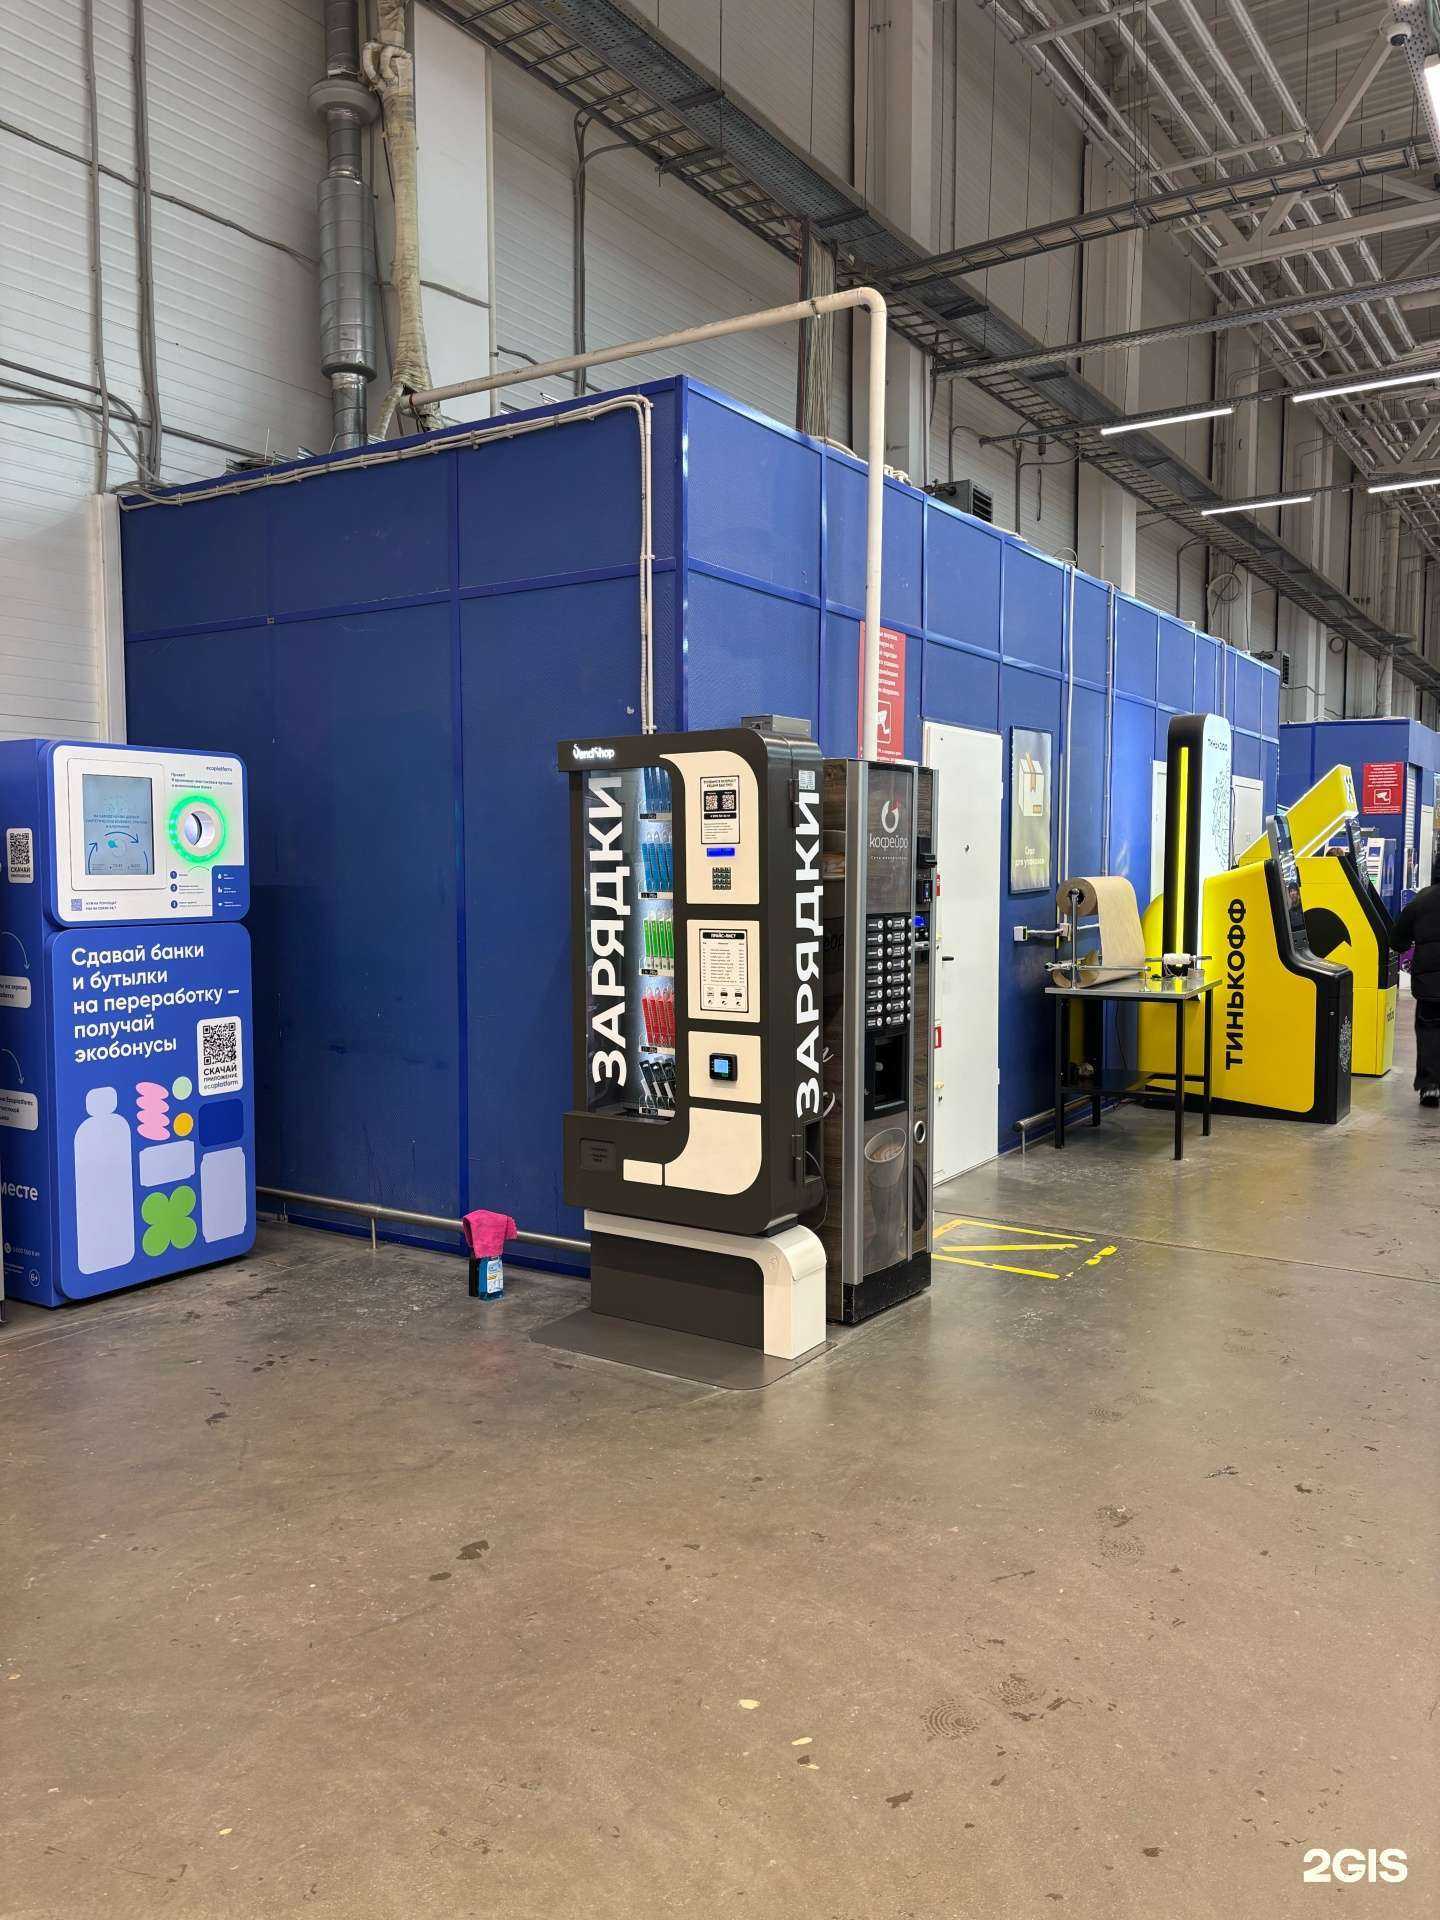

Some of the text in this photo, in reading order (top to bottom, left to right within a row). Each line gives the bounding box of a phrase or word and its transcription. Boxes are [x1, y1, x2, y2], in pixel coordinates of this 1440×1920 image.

[588, 775, 631, 1087] ЗАРЯДКИ
[72, 944, 204, 968] Сдавай банки
[796, 791, 824, 1119] ЗАРЯДКИ
[72, 970, 168, 992] и бутылки
[1226, 899, 1246, 1070] ТИНЬКОФФ
[73, 999, 98, 1014] на
[104, 988, 223, 1013] переработку
[74, 1014, 154, 1039] получай
[74, 1038, 177, 1063] экобонусы
[203, 1063, 237, 1076] СКАЧАЙ
